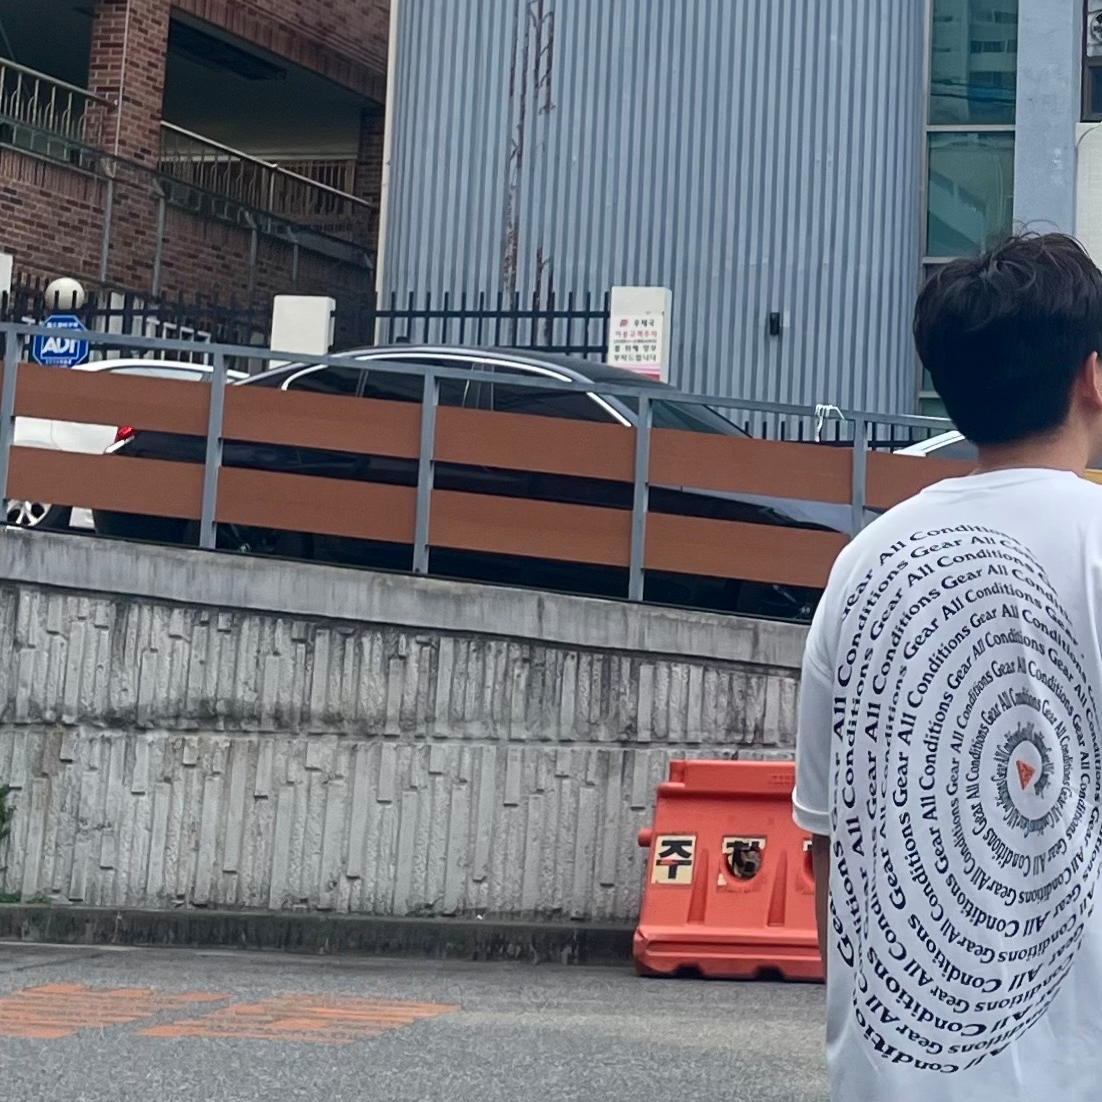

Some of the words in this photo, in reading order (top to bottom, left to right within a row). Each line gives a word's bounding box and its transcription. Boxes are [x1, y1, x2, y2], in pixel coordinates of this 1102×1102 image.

[879, 540, 907, 567] All
[910, 539, 962, 559] Gear
[970, 535, 996, 545] All
[907, 563, 936, 588] All
[936, 549, 1035, 574] Conditions
[940, 568, 983, 590] Gear
[987, 564, 1009, 576] All
[869, 587, 903, 641] Gear
[941, 595, 965, 621] All
[964, 582, 1043, 610] Conditions
[1001, 603, 1020, 620] All
[834, 560, 909, 688] Conditions
[969, 608, 997, 629] Gear
[872, 588, 941, 695] Conditions
[903, 617, 939, 660] Gear
[972, 637, 986, 661] All
[984, 628, 1046, 656] Conditions
[1021, 609, 1087, 684] Conditions
[907, 625, 971, 709] Conditions
[946, 655, 972, 690] Gear
[990, 660, 1016, 678] Gear
[1047, 647, 1074, 683] Gear
[956, 670, 994, 730] Conditions
[1028, 660, 1074, 717] Conditions
[1073, 683, 1088, 708] All
[834, 696, 847, 743] All
[841, 647, 874, 809] Conditions
[864, 702, 882, 743] All
[897, 711, 917, 747] All
[980, 702, 1002, 726] Gear
[1072, 713, 1086, 747] Gear
[918, 691, 954, 791] Conditions
[949, 730, 965, 754] All
[965, 723, 990, 782] Conditions
[1085, 707, 1102, 803] Conditions
[945, 757, 960, 796] Gear
[1079, 751, 1091, 770] All
[866, 750, 878, 821] Gear
[892, 751, 909, 808] Gear
[965, 782, 981, 800] All
[919, 794, 938, 821] All
[970, 801, 988, 836] Gear
[1065, 772, 1091, 841] Conditions
[845, 815, 865, 857] All
[950, 797, 976, 875] Conditions
[1084, 806, 1100, 848] Gear
[899, 812, 944, 922] Conditions
[928, 826, 950, 875] Gear
[982, 827, 1031, 878] Conditions
[1070, 845, 1084, 874] All
[880, 847, 907, 910] Gear
[970, 866, 992, 891] All
[986, 877, 1017, 907] Gear
[1018, 866, 1072, 905] Conditions
[945, 873, 1020, 938] Conditions
[1052, 883, 1082, 919] Gear
[826, 889, 855, 968] Gea
[939, 917, 961, 944] All
[997, 913, 1077, 963] Conditions
[1022, 910, 1051, 938] All
[907, 914, 1002, 994] Conditions
[956, 933, 996, 965] Gear
[903, 958, 934, 987] All
[1007, 962, 1044, 993] All
[865, 994, 901, 1024] All
[867, 947, 987, 1037] Conditions
[929, 980, 970, 1014] Gear
[852, 989, 959, 1074] Conditio
[895, 1019, 943, 1055] Gear
